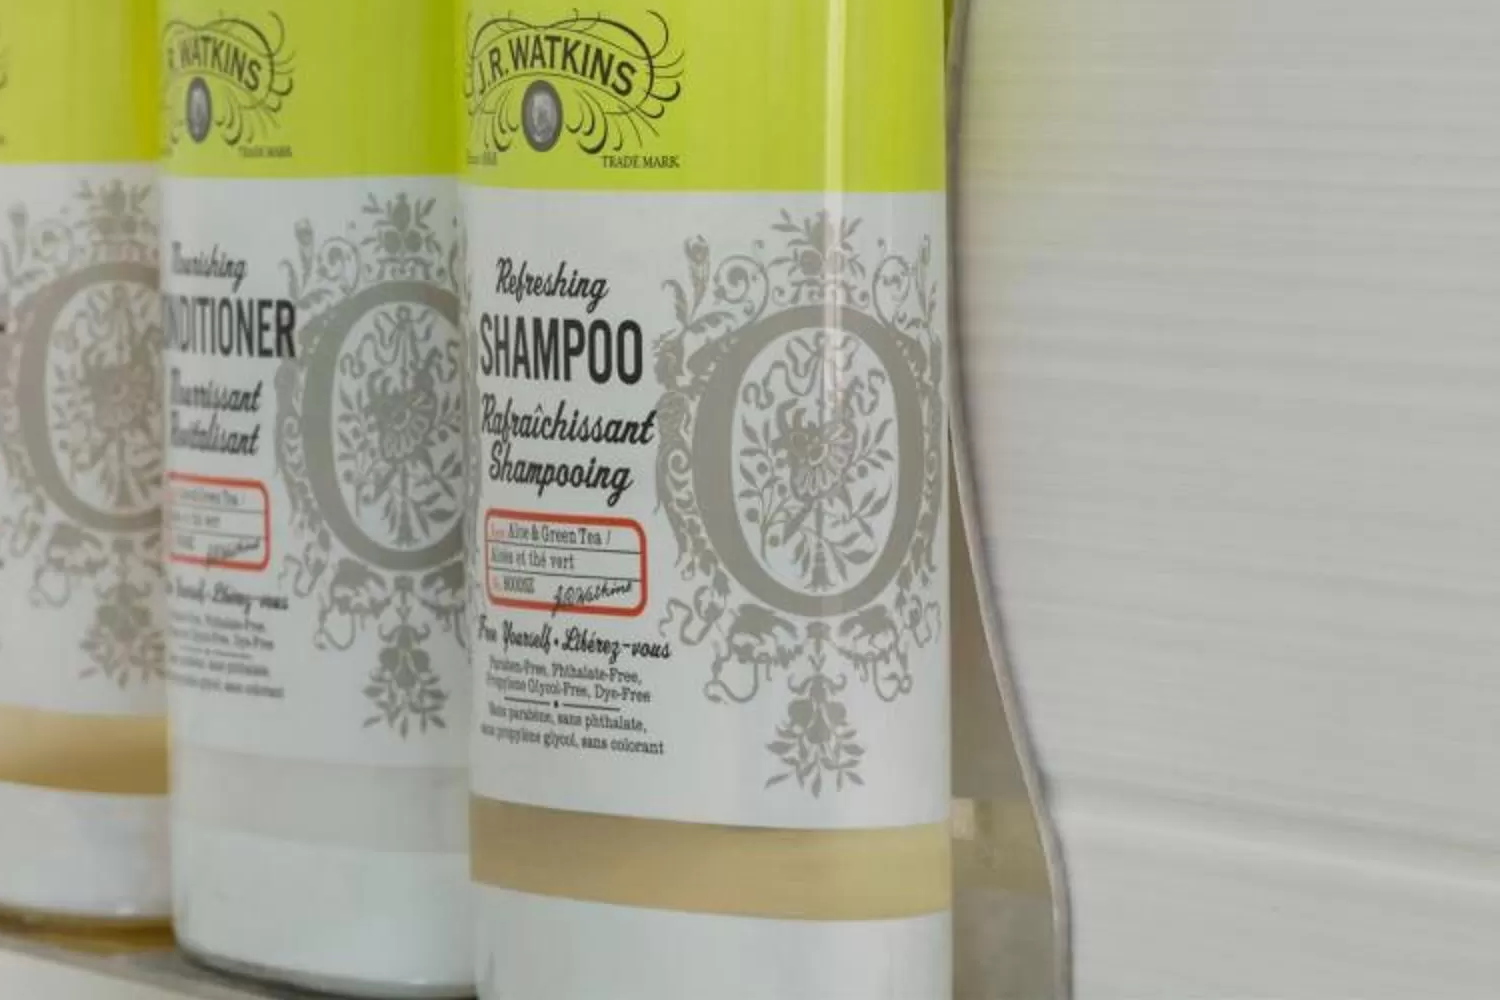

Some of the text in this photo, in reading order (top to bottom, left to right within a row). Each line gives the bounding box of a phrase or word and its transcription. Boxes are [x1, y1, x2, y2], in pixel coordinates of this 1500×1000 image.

[508, 34, 637, 97] WATKINS
[602, 155, 680, 169] TRADE MARK
[496, 256, 610, 314] Refreshing
[480, 312, 643, 385] SHAMPOO
[482, 393, 657, 446] Rafraîchissant
[488, 439, 634, 507] Shampooing
[542, 526, 577, 544] Green
[578, 528, 602, 545] Tea
[503, 619, 551, 654] Yourself
[562, 626, 671, 664] Libérez-vous
[585, 714, 647, 733] phthalate,
[610, 737, 664, 756] colorant
